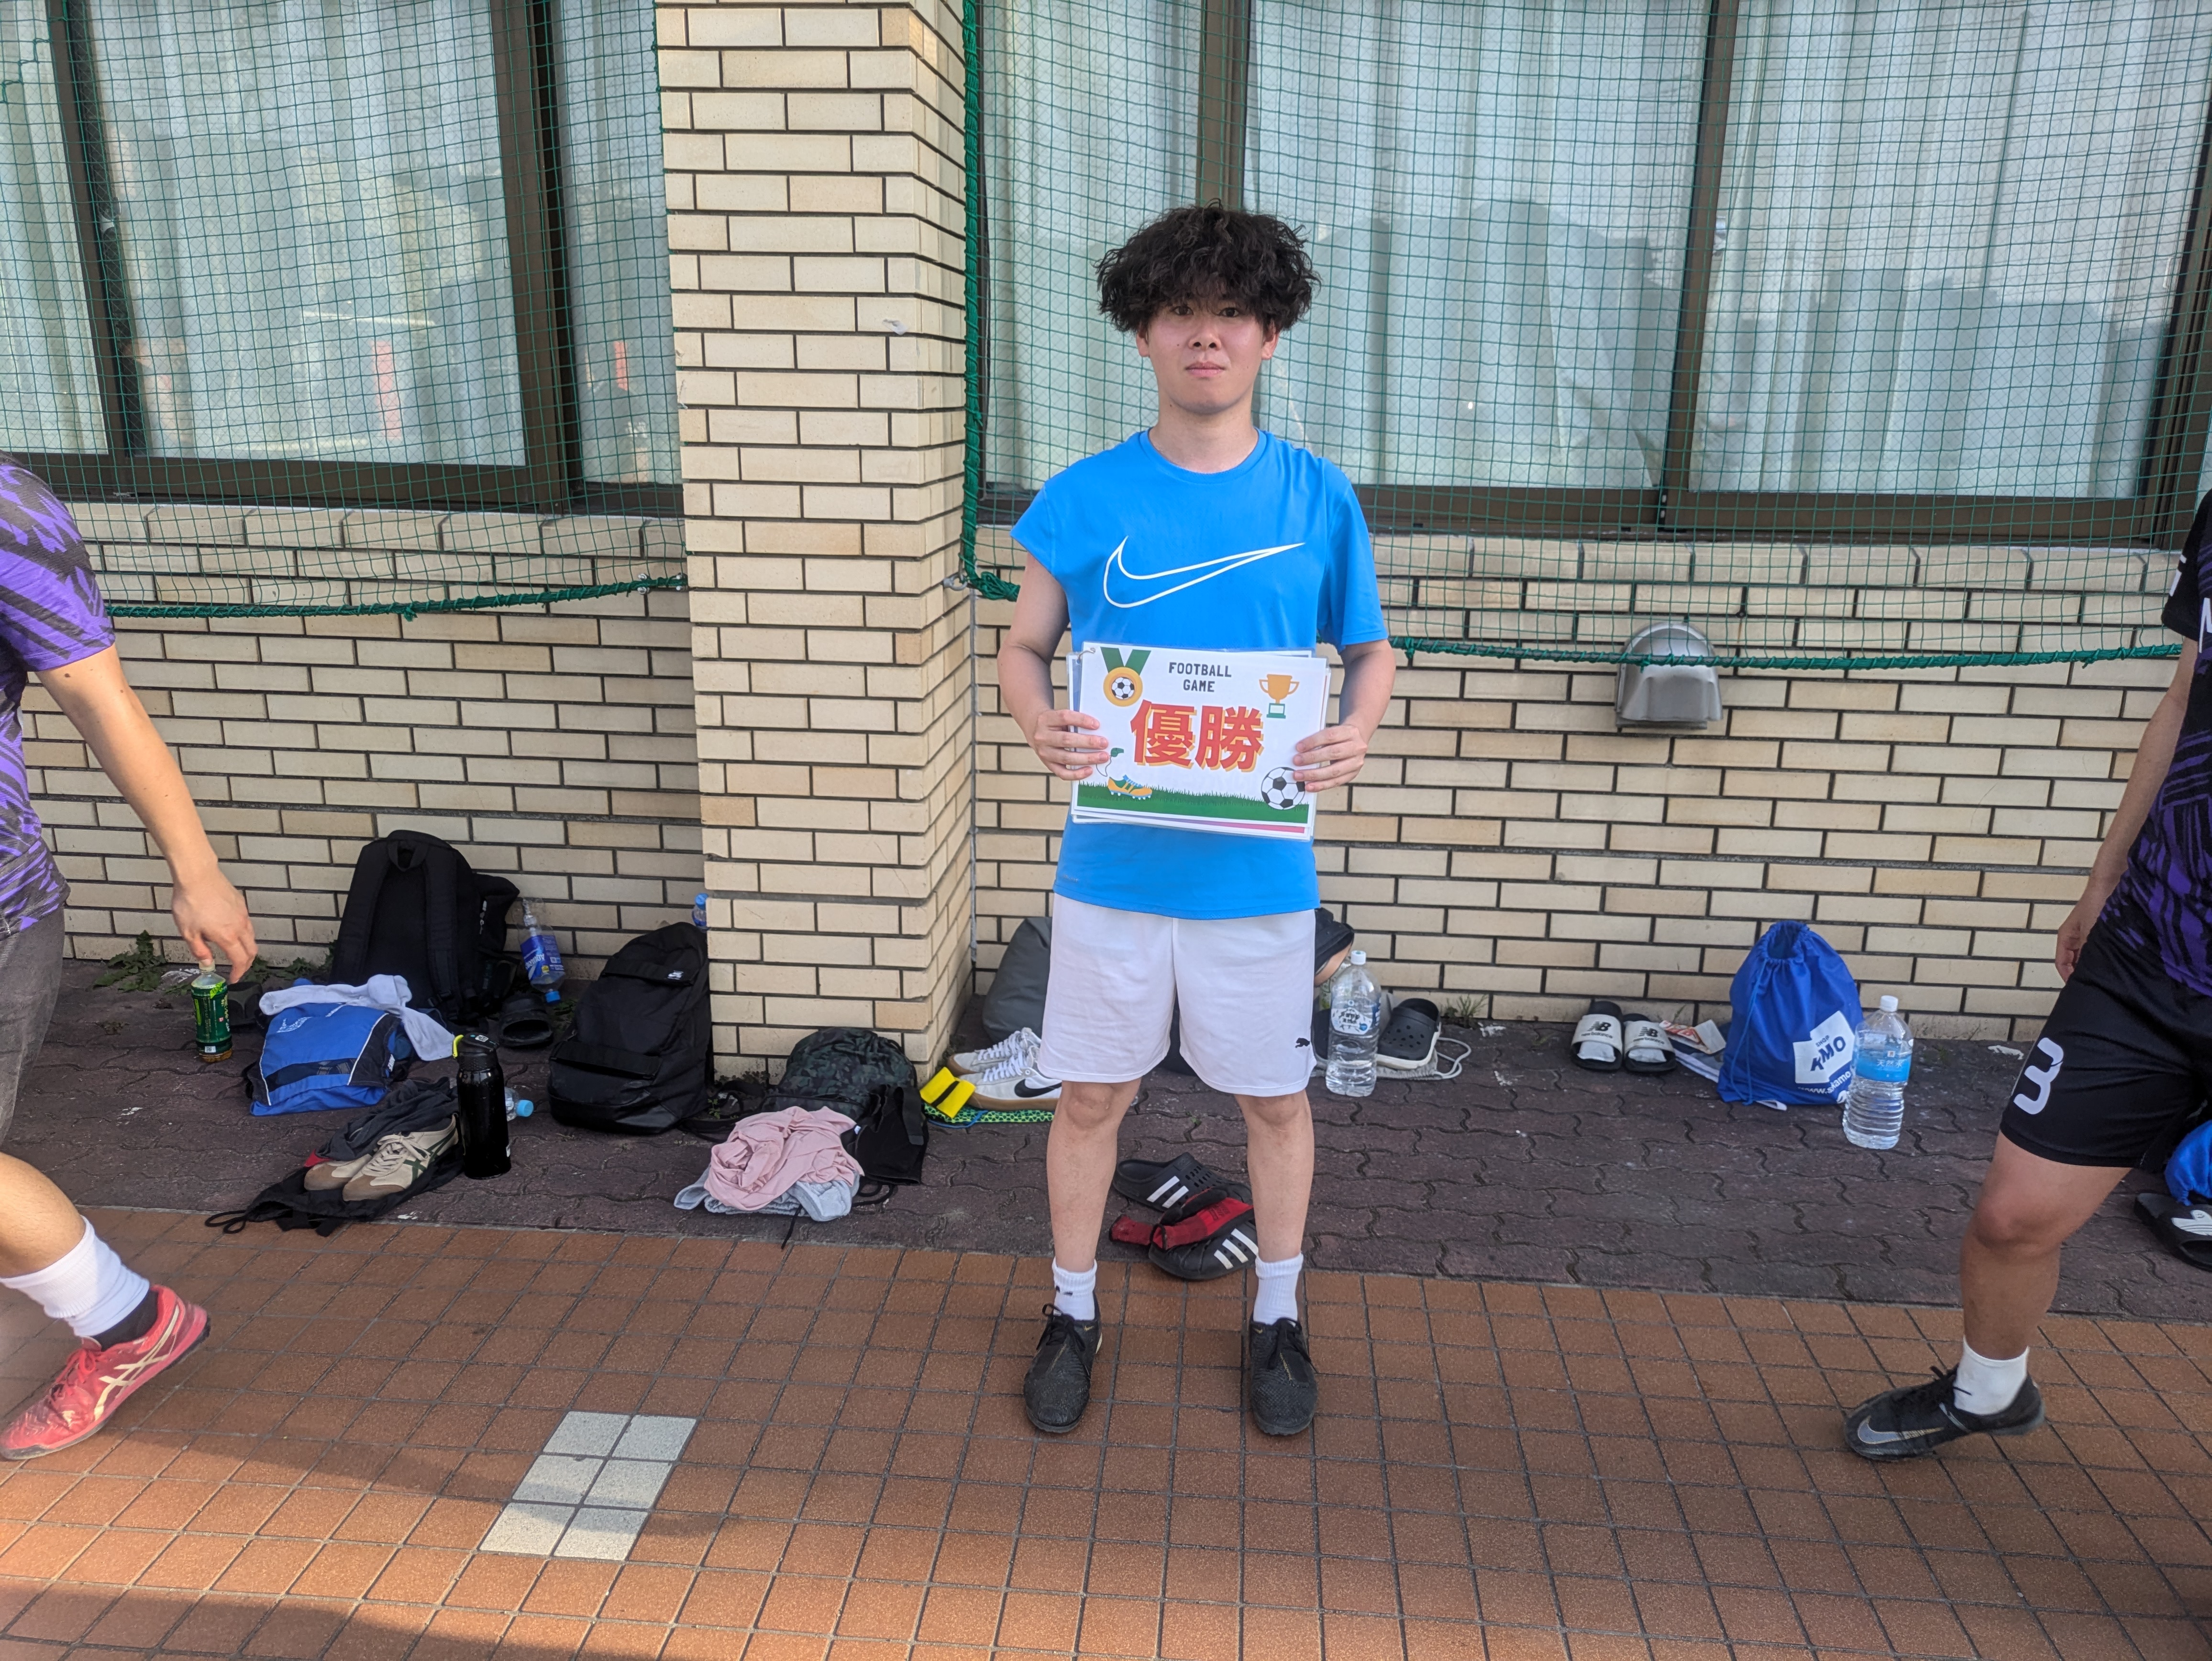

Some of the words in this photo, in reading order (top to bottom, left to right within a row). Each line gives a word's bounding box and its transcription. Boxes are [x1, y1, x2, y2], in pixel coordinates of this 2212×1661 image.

[1168, 662, 1232, 678] FOOTBALL
[1183, 679, 1215, 693] GAME
[1130, 699, 1264, 772] 優勝
[1815, 1035, 1830, 1047] SHOP
[2013, 1037, 2064, 1115] 3
